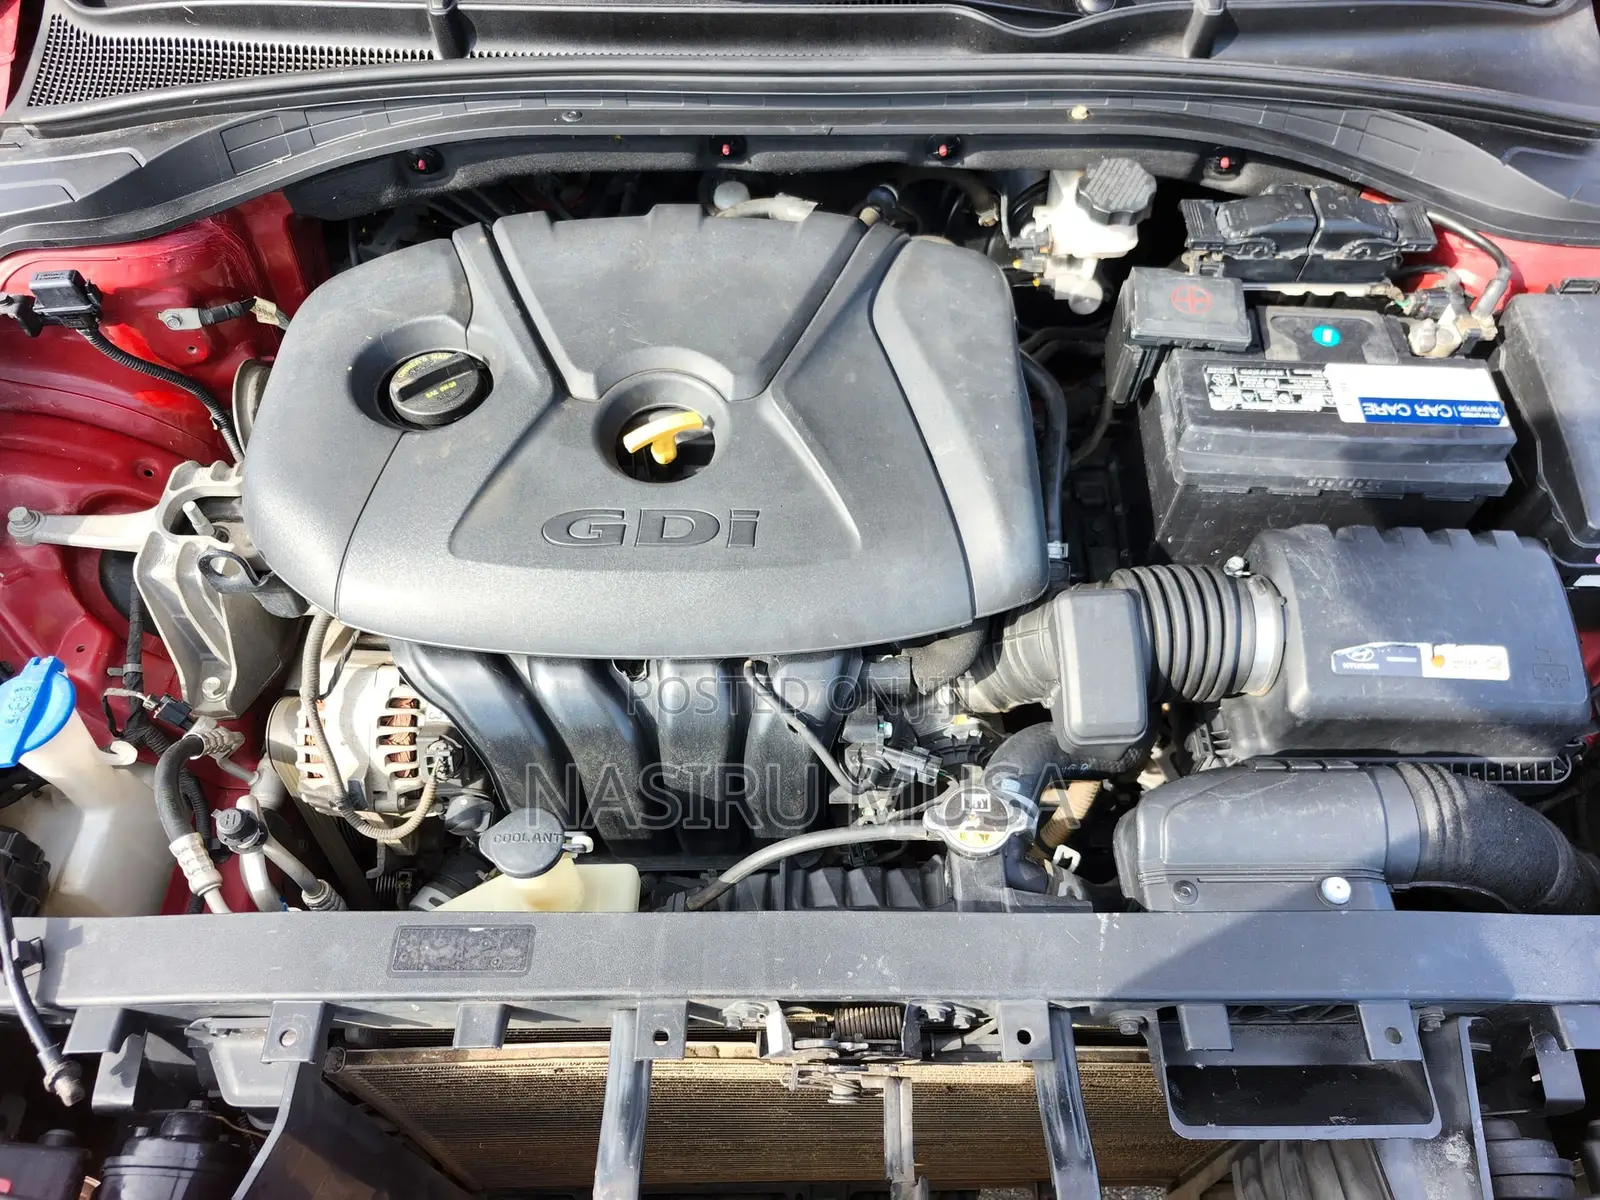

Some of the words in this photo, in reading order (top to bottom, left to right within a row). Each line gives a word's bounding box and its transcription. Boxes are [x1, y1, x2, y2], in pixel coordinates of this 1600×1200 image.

[1362, 402, 1412, 417] CARE
[1414, 403, 1453, 417] CAR
[541, 508, 762, 548] GDi
[225, 813, 237, 826] H
[493, 832, 563, 844] COOLANT
